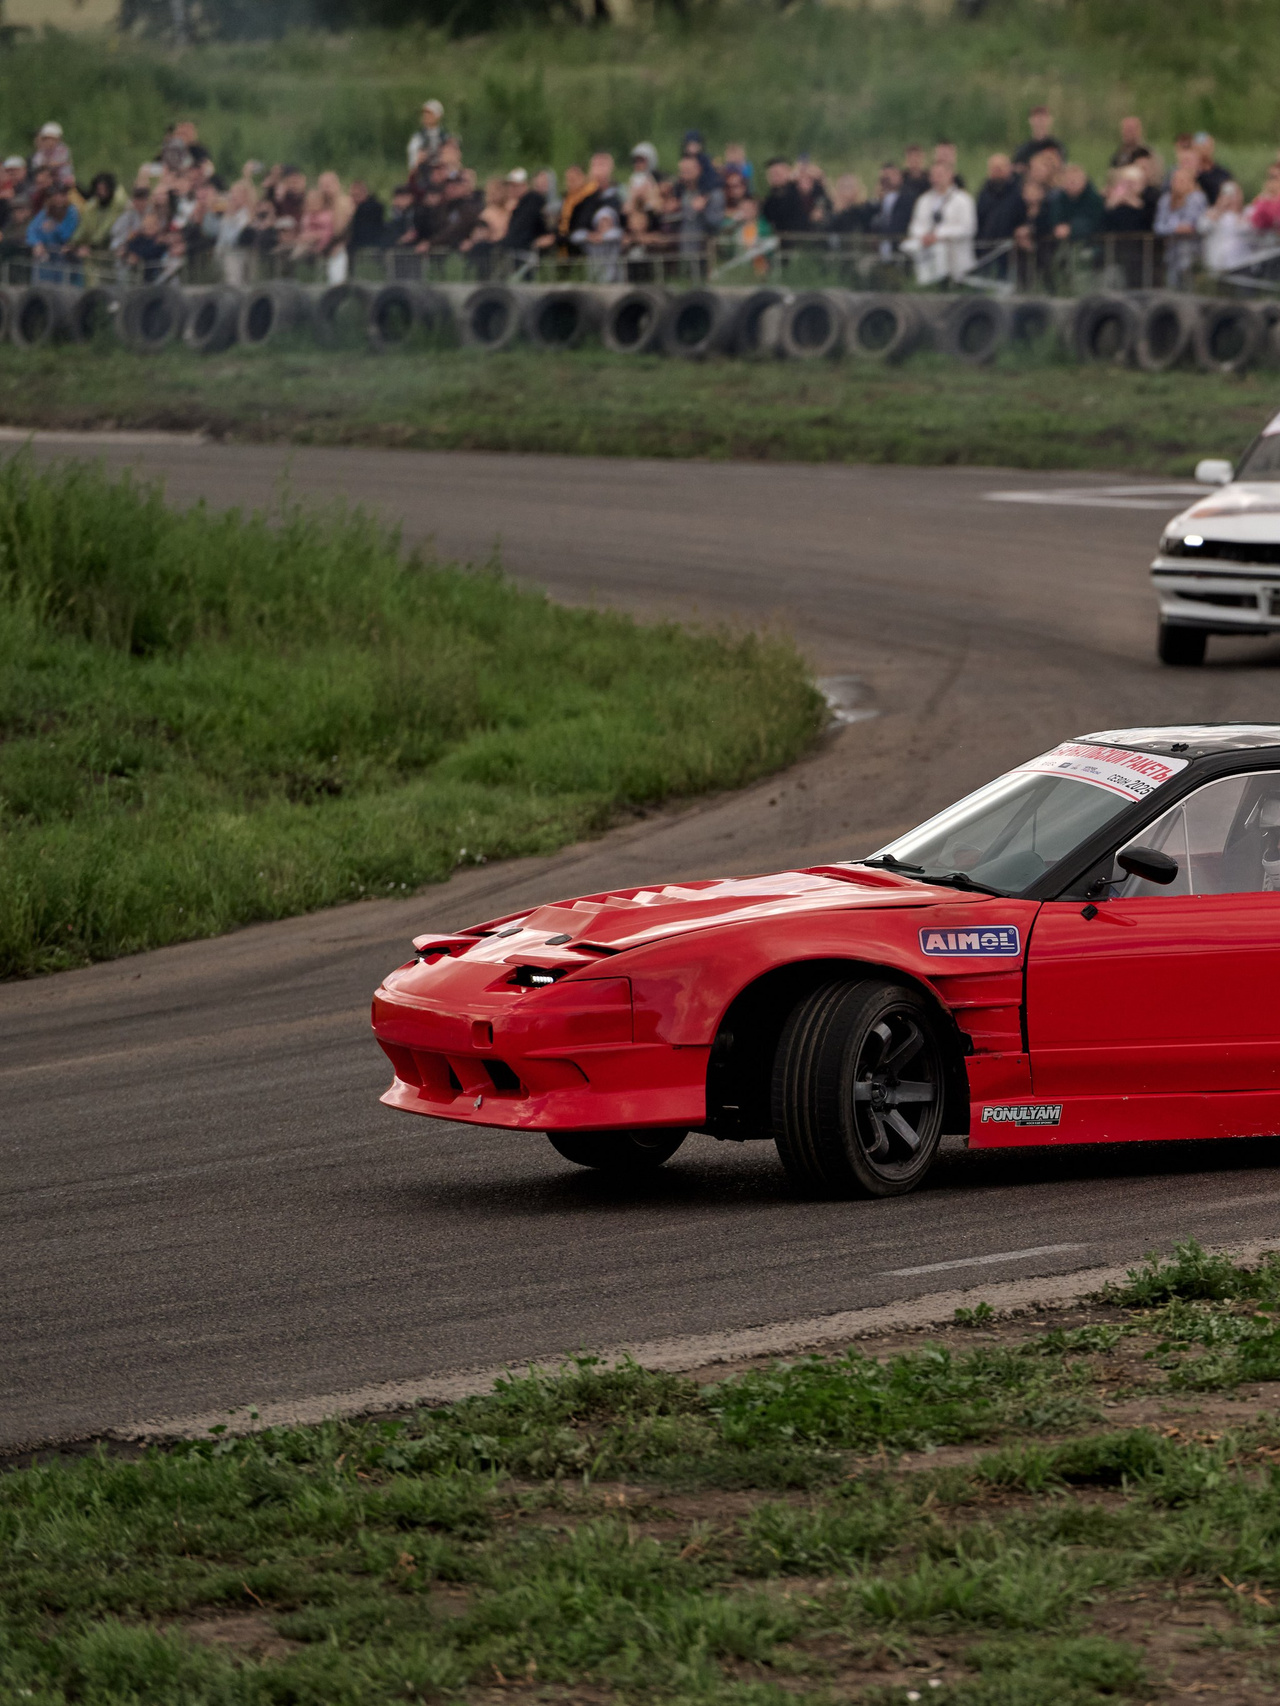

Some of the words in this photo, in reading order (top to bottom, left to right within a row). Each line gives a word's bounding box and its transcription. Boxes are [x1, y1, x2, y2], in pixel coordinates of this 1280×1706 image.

[1126, 779, 1156, 795] 2025
[926, 932, 1015, 950] AIMOL
[983, 1106, 1061, 1121] PONULYAM
